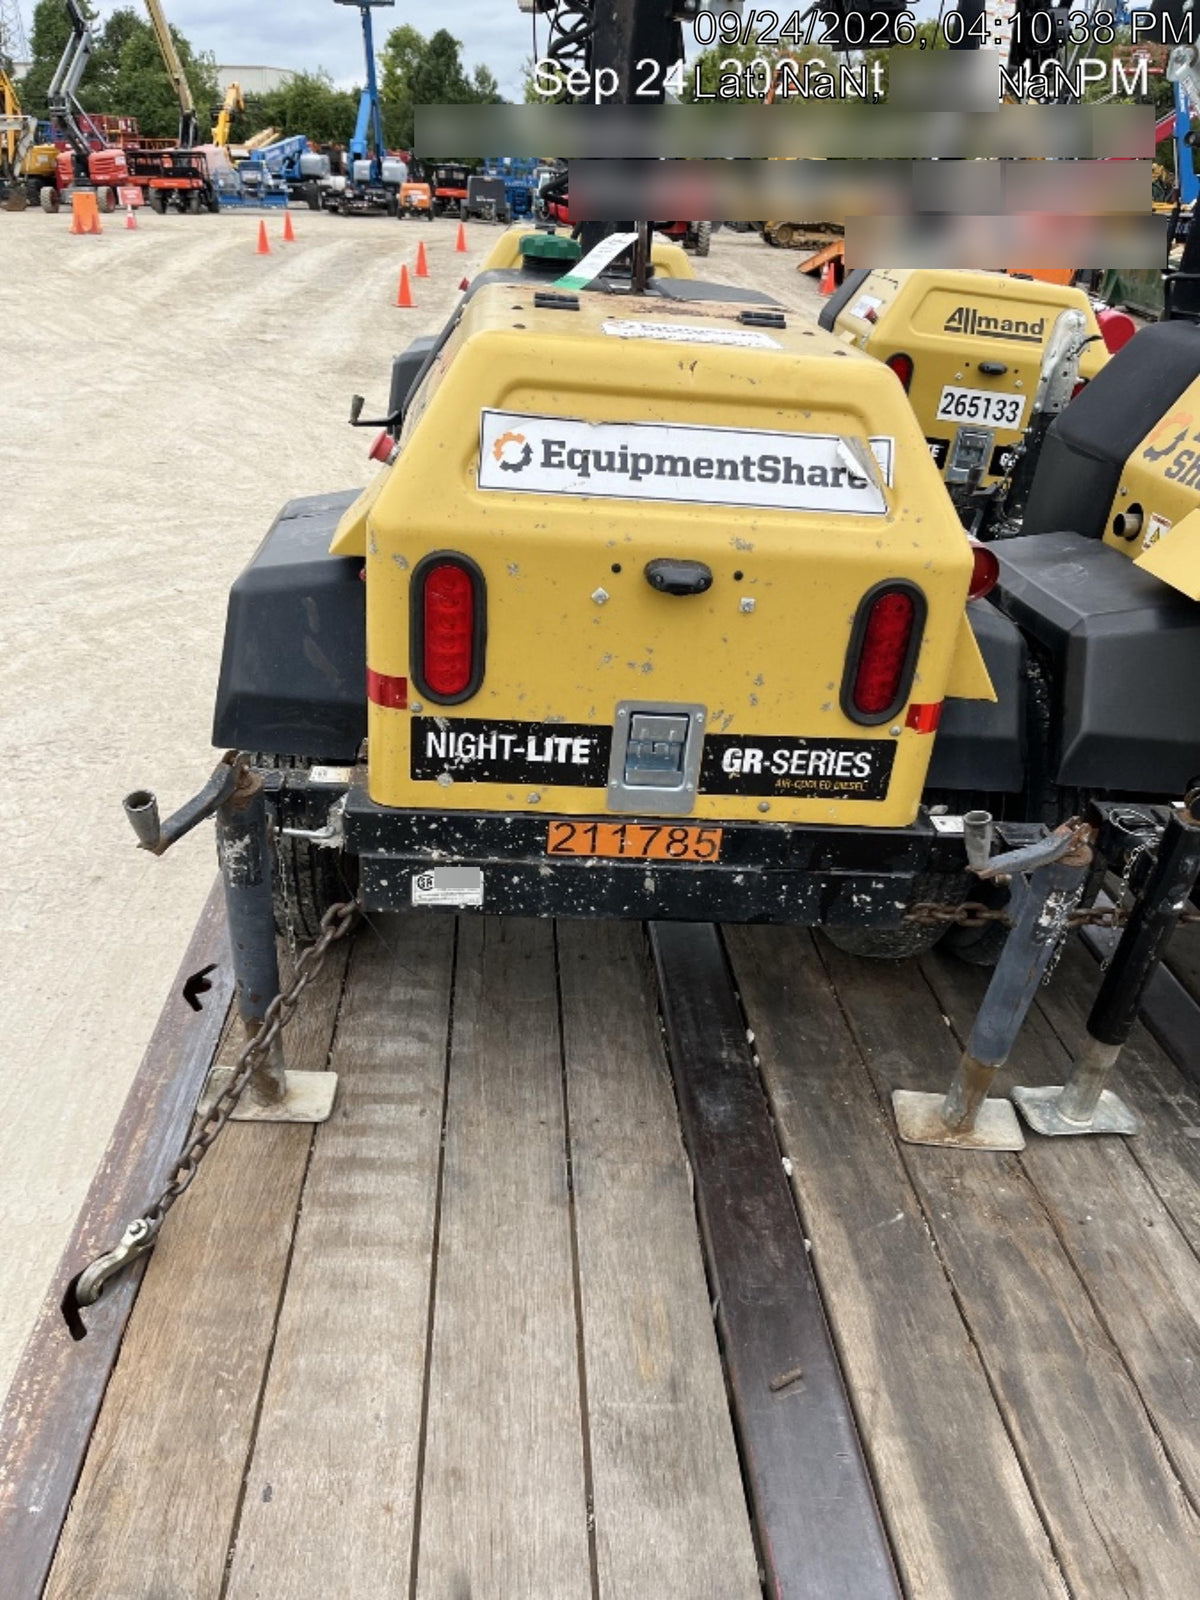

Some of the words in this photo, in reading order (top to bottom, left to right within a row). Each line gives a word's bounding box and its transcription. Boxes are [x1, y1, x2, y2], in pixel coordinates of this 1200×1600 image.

[945, 307, 1045, 337] Allmand
[940, 392, 1020, 423] 265133
[426, 731, 593, 765] NIGHT-LITE
[722, 748, 873, 778] GR-SERIES
[550, 822, 719, 858] 211785
